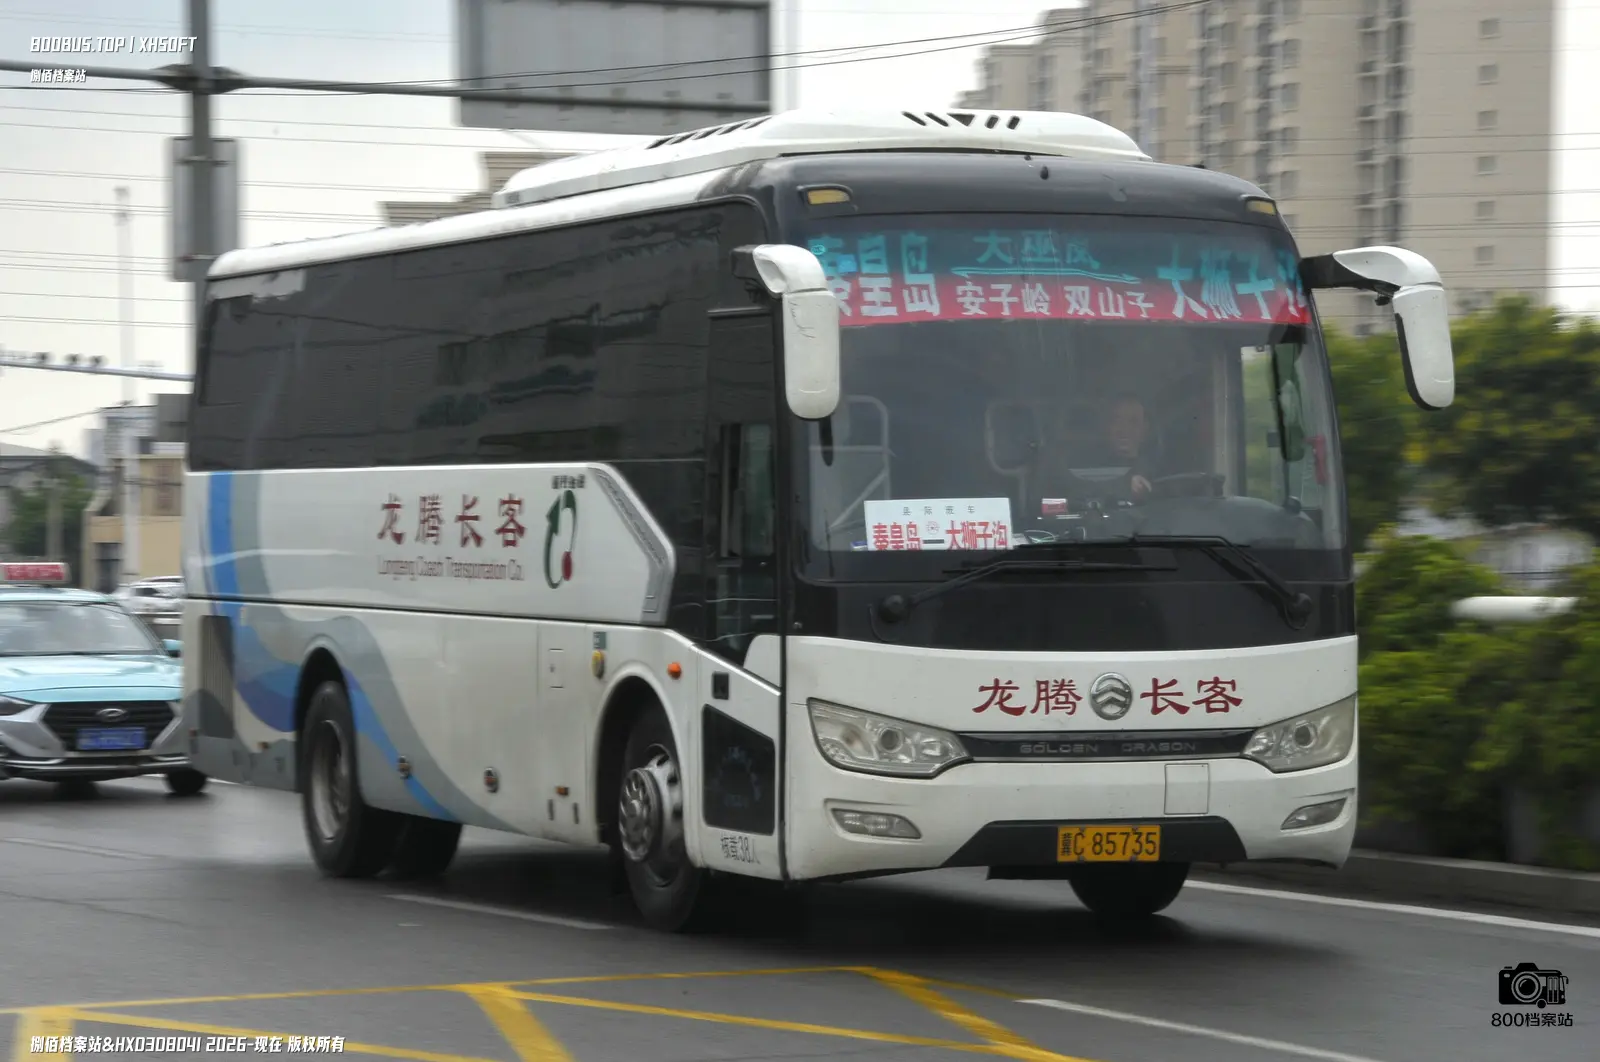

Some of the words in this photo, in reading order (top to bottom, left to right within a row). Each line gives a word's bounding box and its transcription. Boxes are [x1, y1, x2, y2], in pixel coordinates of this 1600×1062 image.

[956, 281, 1052, 316] 安子岭
[1064, 285, 1155, 319] 双山子
[377, 494, 526, 547] 龙腾长客
[972, 677, 1083, 716] 龙腾
[1140, 676, 1244, 715] 长客
[1019, 741, 1099, 754] GOLDEN
[1121, 741, 1197, 753] DRAGON
